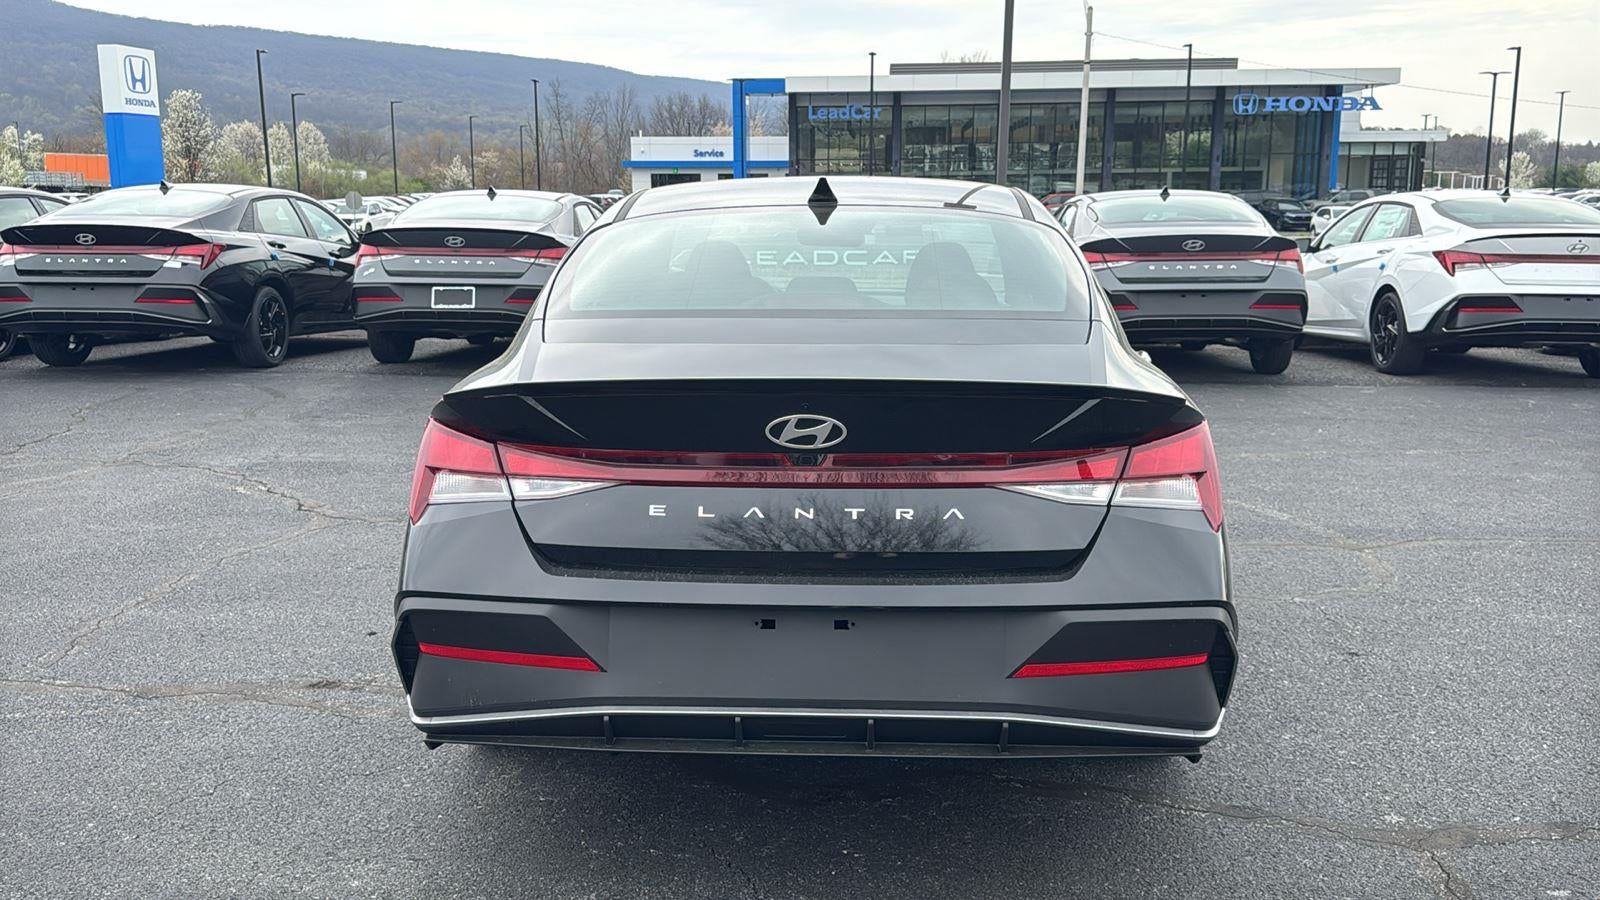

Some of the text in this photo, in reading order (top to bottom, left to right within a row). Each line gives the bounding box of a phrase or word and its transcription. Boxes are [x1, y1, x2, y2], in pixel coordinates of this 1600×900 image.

[125, 97, 157, 108] HONDA
[1263, 96, 1383, 112] HONDA
[808, 104, 882, 120] LeadCar
[693, 149, 724, 157] Service
[648, 504, 965, 520] ELANTRA
